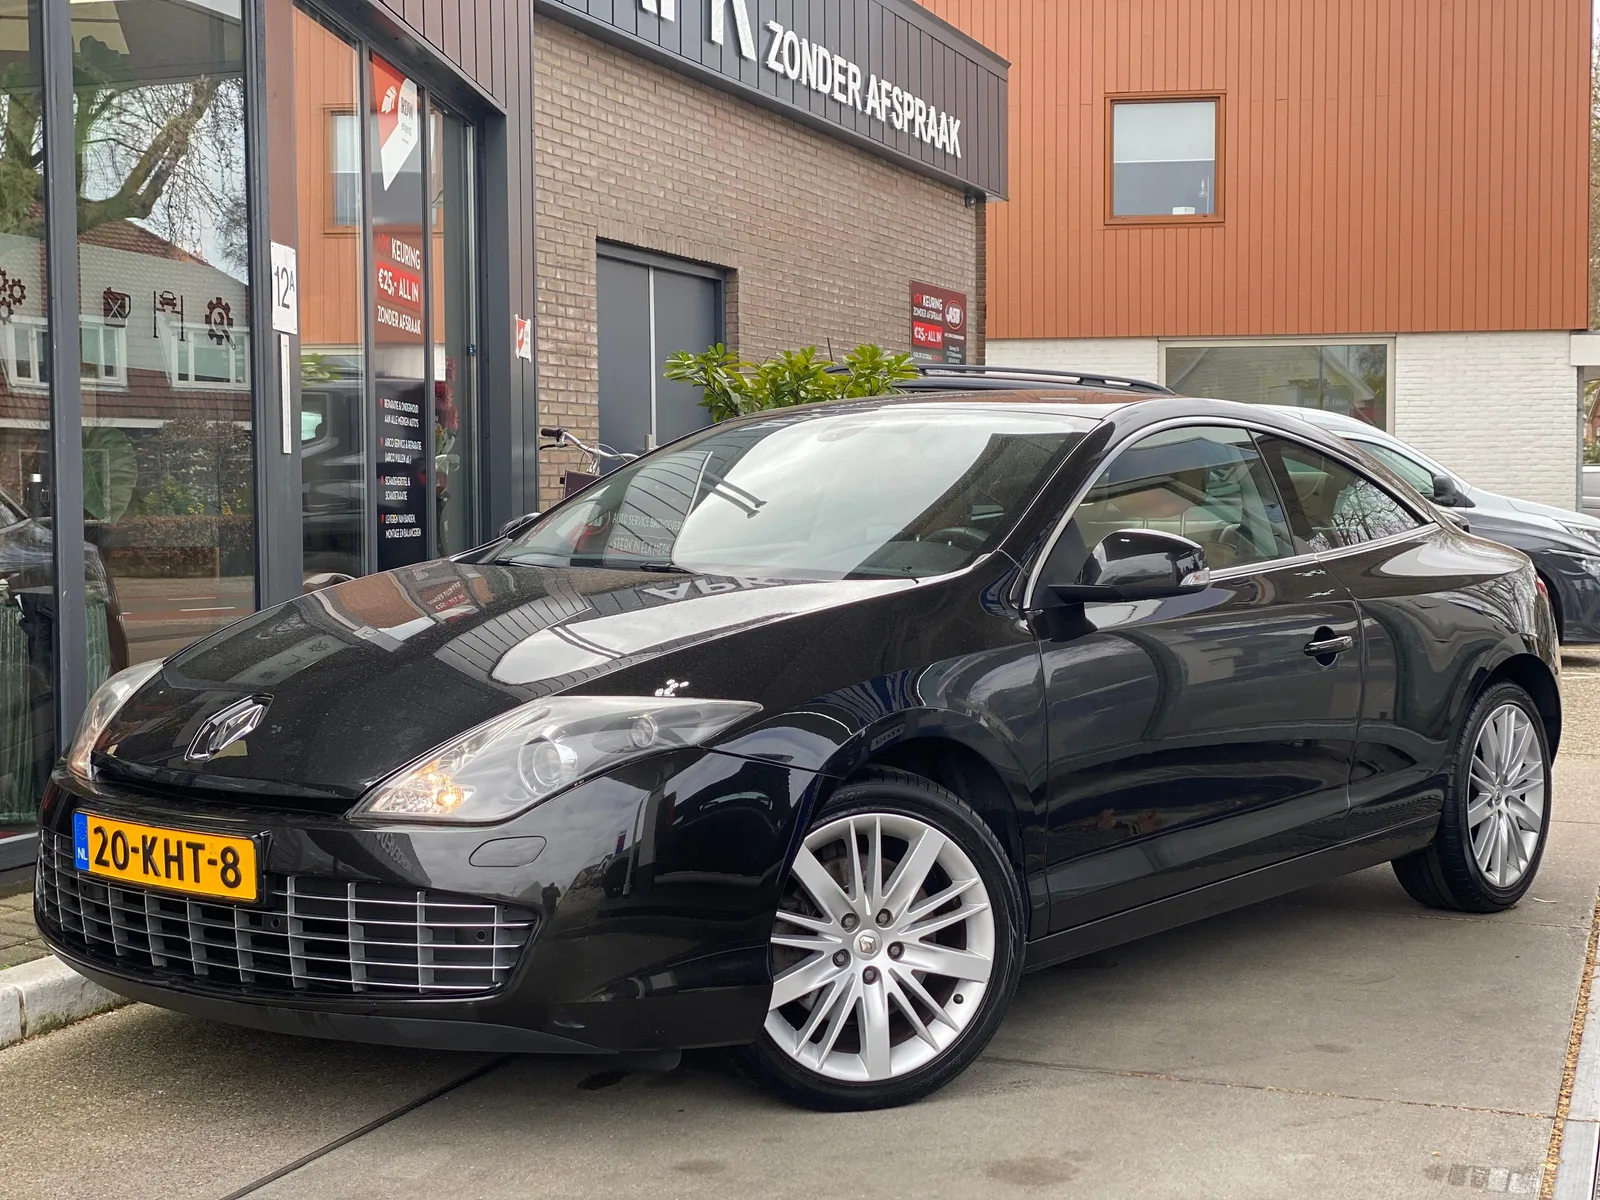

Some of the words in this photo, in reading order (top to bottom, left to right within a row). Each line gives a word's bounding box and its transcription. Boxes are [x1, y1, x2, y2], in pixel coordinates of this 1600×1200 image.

[766, 20, 862, 111] ZONDER
[866, 73, 962, 158] AFSPRAAK
[391, 238, 420, 270] KEURING
[378, 267, 397, 296] €25,-
[399, 277, 411, 300] ALL
[412, 281, 419, 302] IN
[377, 305, 399, 328] ZONDER
[923, 294, 942, 310] KEURING
[928, 330, 936, 342] ALL
[77, 847, 88, 861] NL
[93, 826, 242, 888] 20-KHT-8
